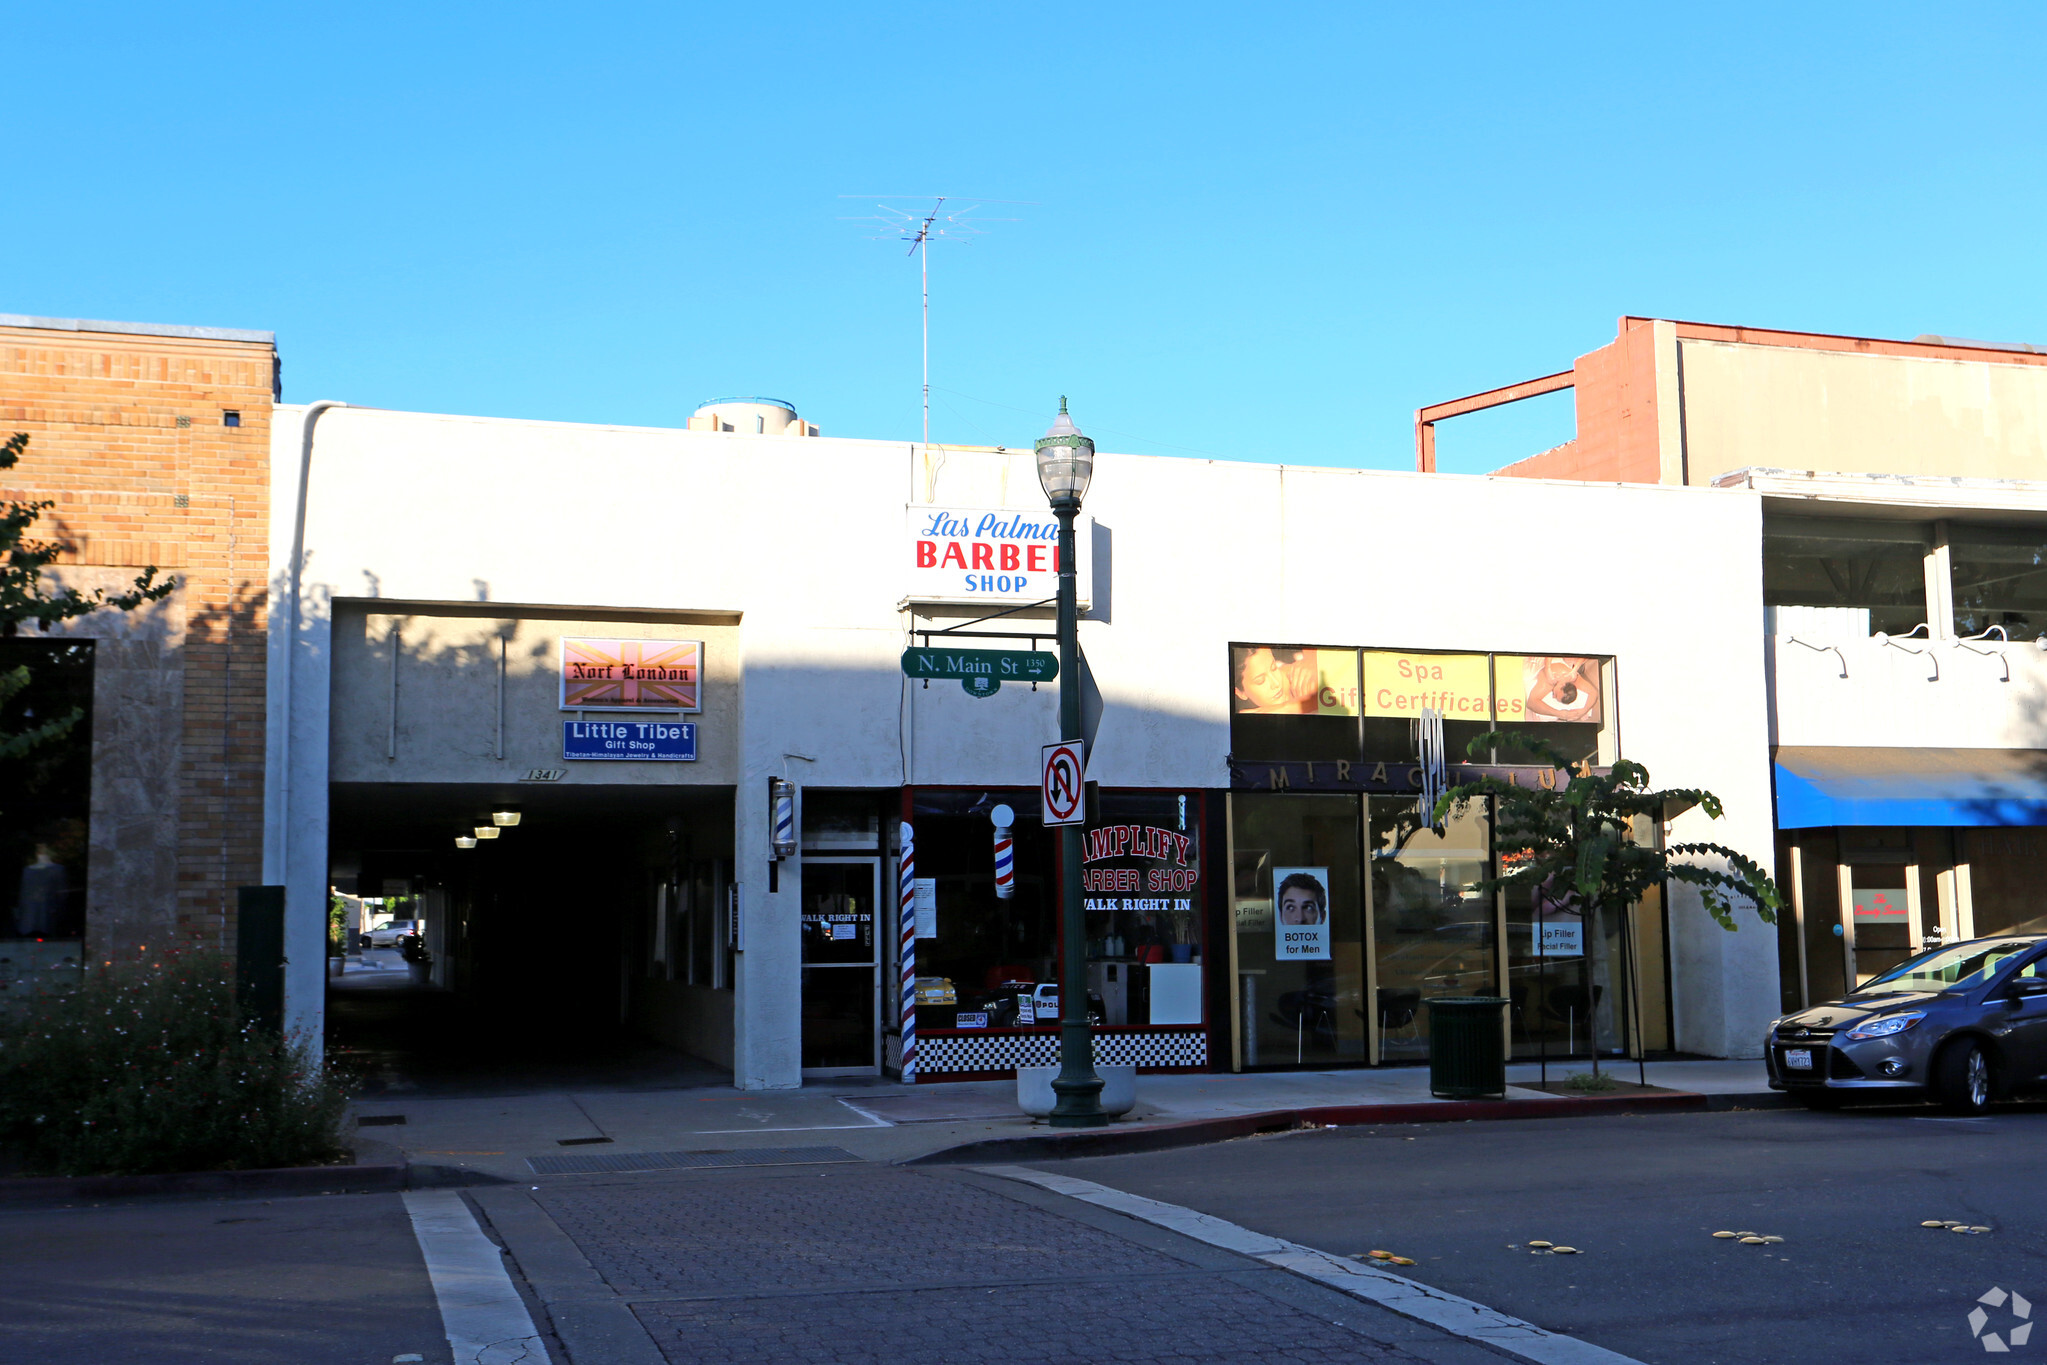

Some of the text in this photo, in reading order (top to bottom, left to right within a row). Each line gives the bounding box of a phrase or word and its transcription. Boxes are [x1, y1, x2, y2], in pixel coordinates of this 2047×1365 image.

[921, 511, 1060, 541] Las Palma
[965, 573, 1028, 593] SHOP
[918, 654, 1046, 675] N. Main St 1350
[572, 662, 689, 681] Norf London
[1397, 658, 1444, 684] Spa
[1318, 685, 1366, 709] Gif
[572, 722, 690, 740] Little Tibet
[605, 740, 656, 751] Gift Shop
[625, 752, 650, 760] Jewelry
[657, 752, 695, 760] Handicrafts
[528, 769, 558, 780] 1341
[1083, 868, 1198, 892] ARBER SHOP
[1084, 898, 1191, 911] ALK RIGHT IN
[828, 913, 859, 922] RIGHT
[859, 913, 872, 922] IN
[1242, 907, 1264, 916] Filler
[1284, 932, 1319, 942] BOTOX
[1554, 929, 1576, 938] Filler
[1285, 944, 1320, 954] for Men
[1559, 942, 1578, 950] Filler
